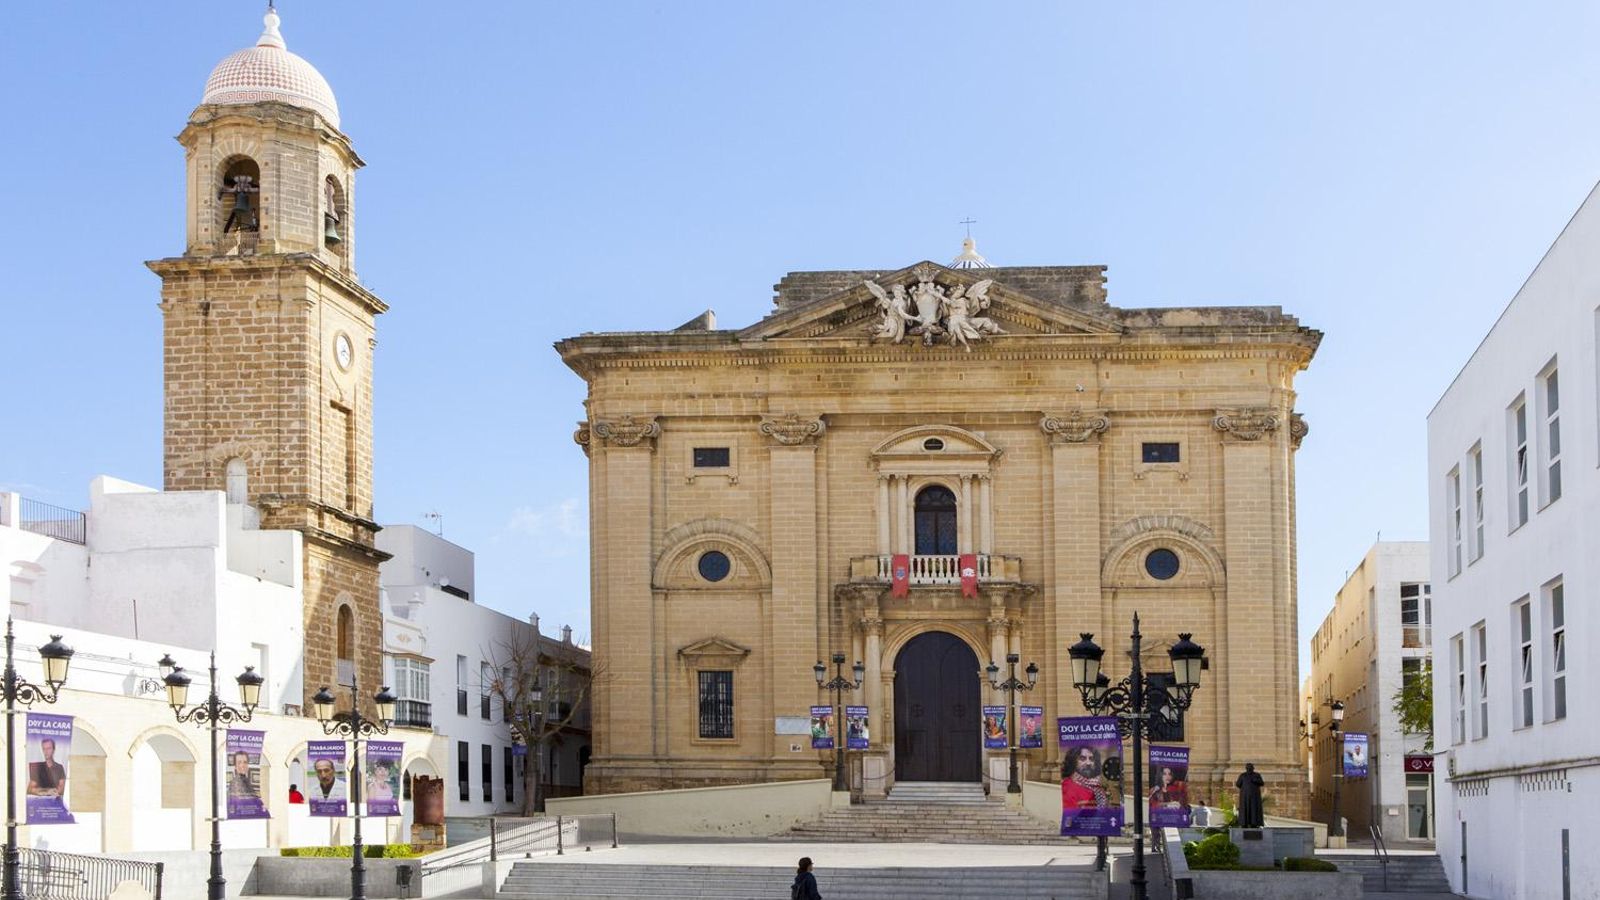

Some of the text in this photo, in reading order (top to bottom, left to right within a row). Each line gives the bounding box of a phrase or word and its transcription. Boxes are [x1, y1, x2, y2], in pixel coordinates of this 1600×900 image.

[28, 719, 41, 728] DOY
[52, 721, 71, 729] CARA
[1061, 723, 1116, 733] DOY LA CARA
